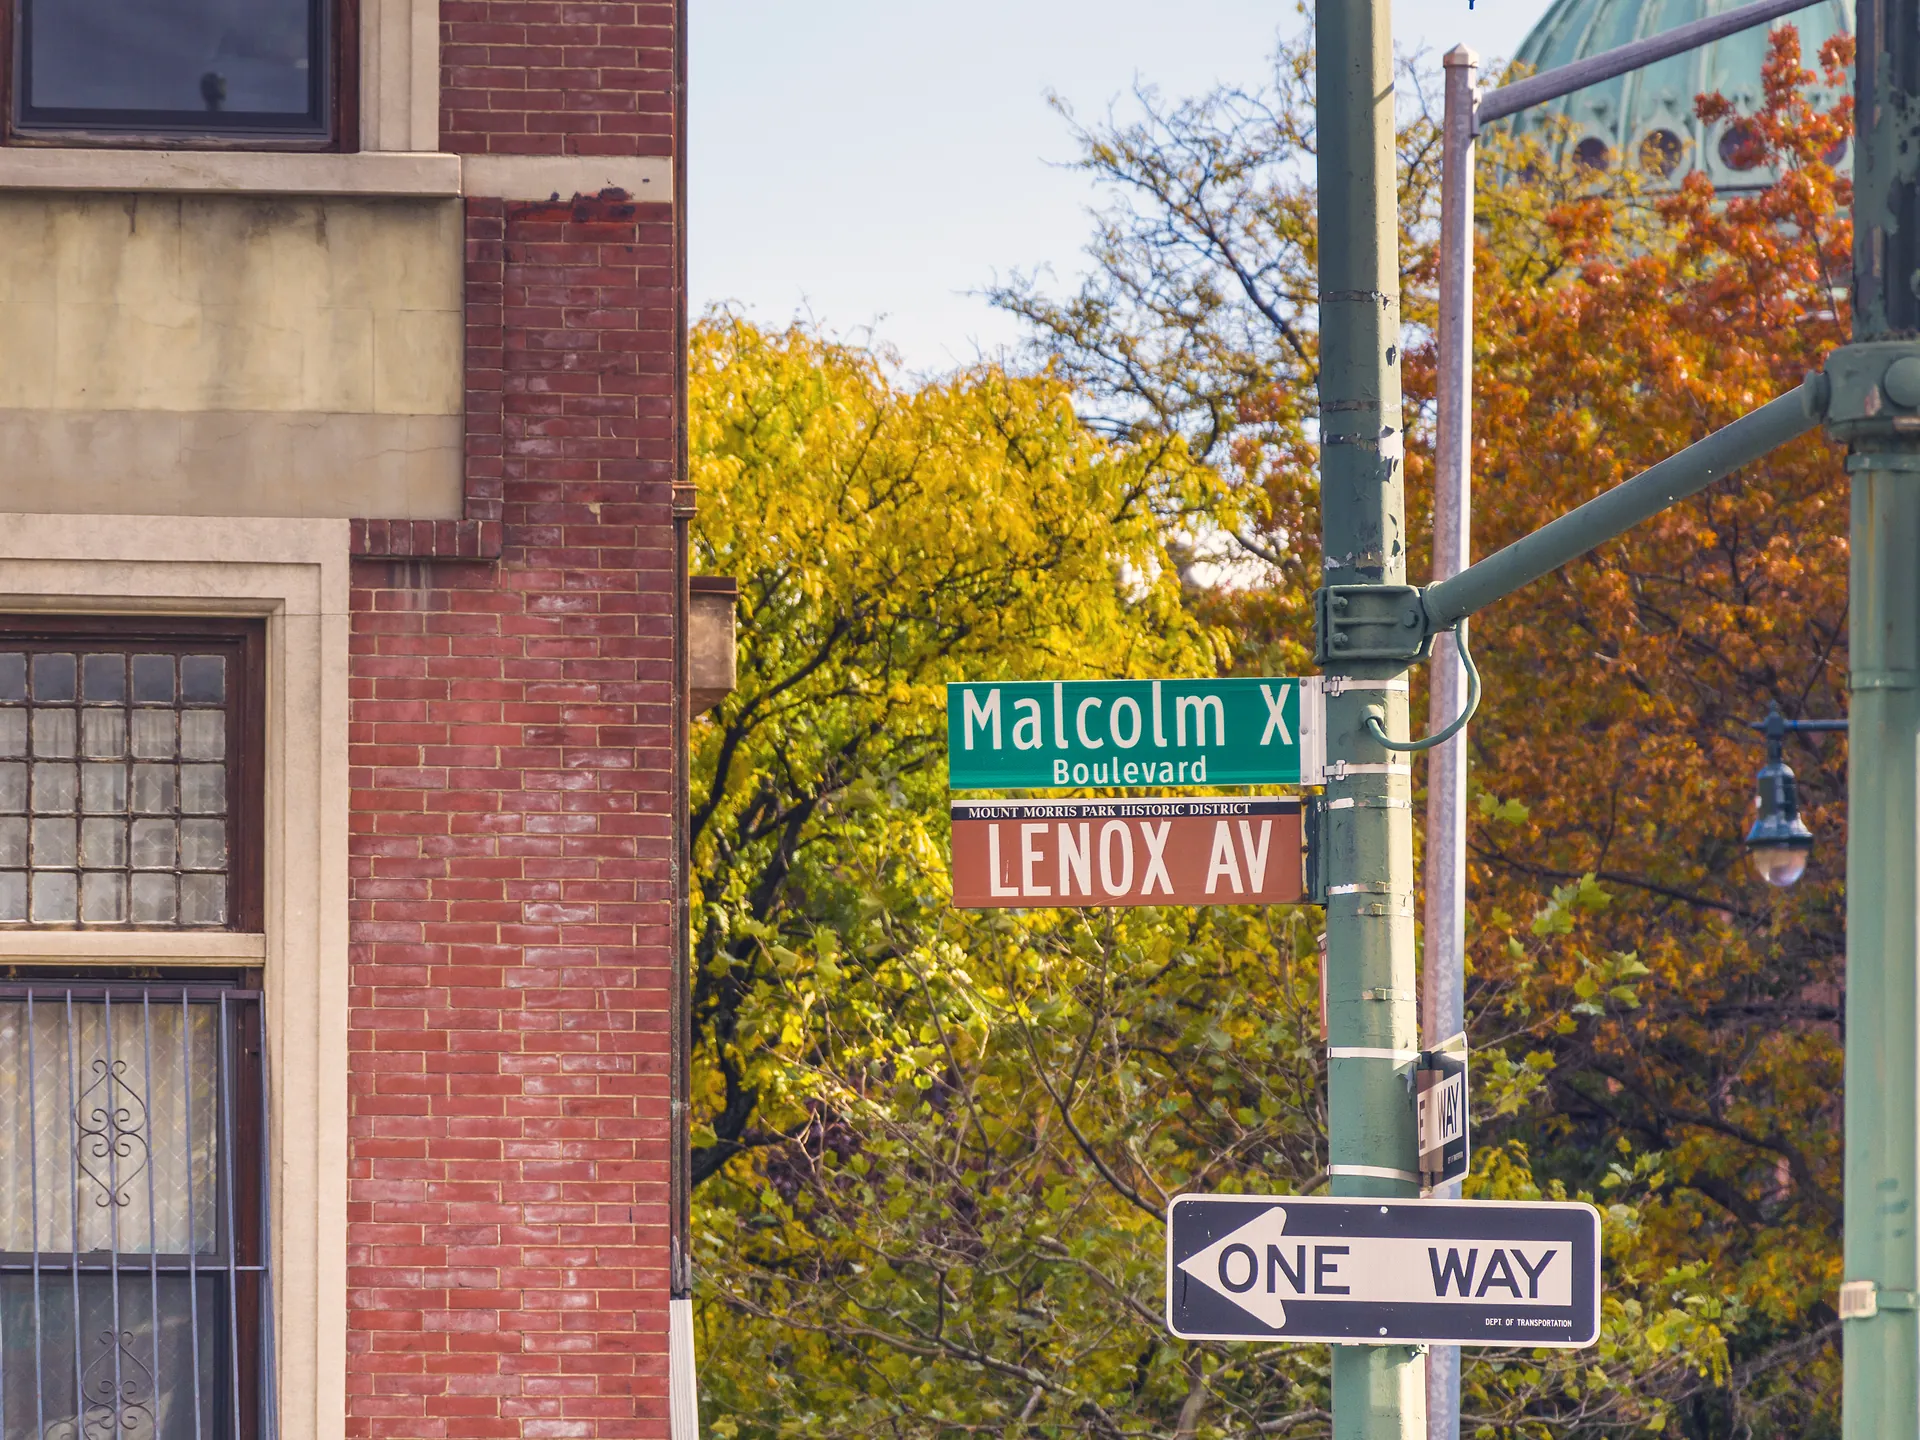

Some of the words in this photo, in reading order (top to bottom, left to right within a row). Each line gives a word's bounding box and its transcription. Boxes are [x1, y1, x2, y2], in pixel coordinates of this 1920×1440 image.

[963, 682, 1225, 750] Malcolm
[1260, 684, 1293, 745] X
[1053, 755, 1207, 785] Boulevard
[968, 807, 1019, 819] MOUNT
[1023, 806, 1077, 817] MORRIS
[1082, 805, 1116, 817] PARK
[1120, 804, 1185, 816] HISTORIC
[1189, 803, 1251, 815] DISTRICT
[988, 820, 1174, 897] LENOX
[1204, 820, 1272, 894] AV
[1437, 1081, 1459, 1141] WAY
[1217, 1243, 1350, 1295] ONE
[1428, 1247, 1557, 1299] WAY
[1505, 1318, 1514, 1326] OF
[1517, 1318, 1572, 1328] TRANSPORTATION
